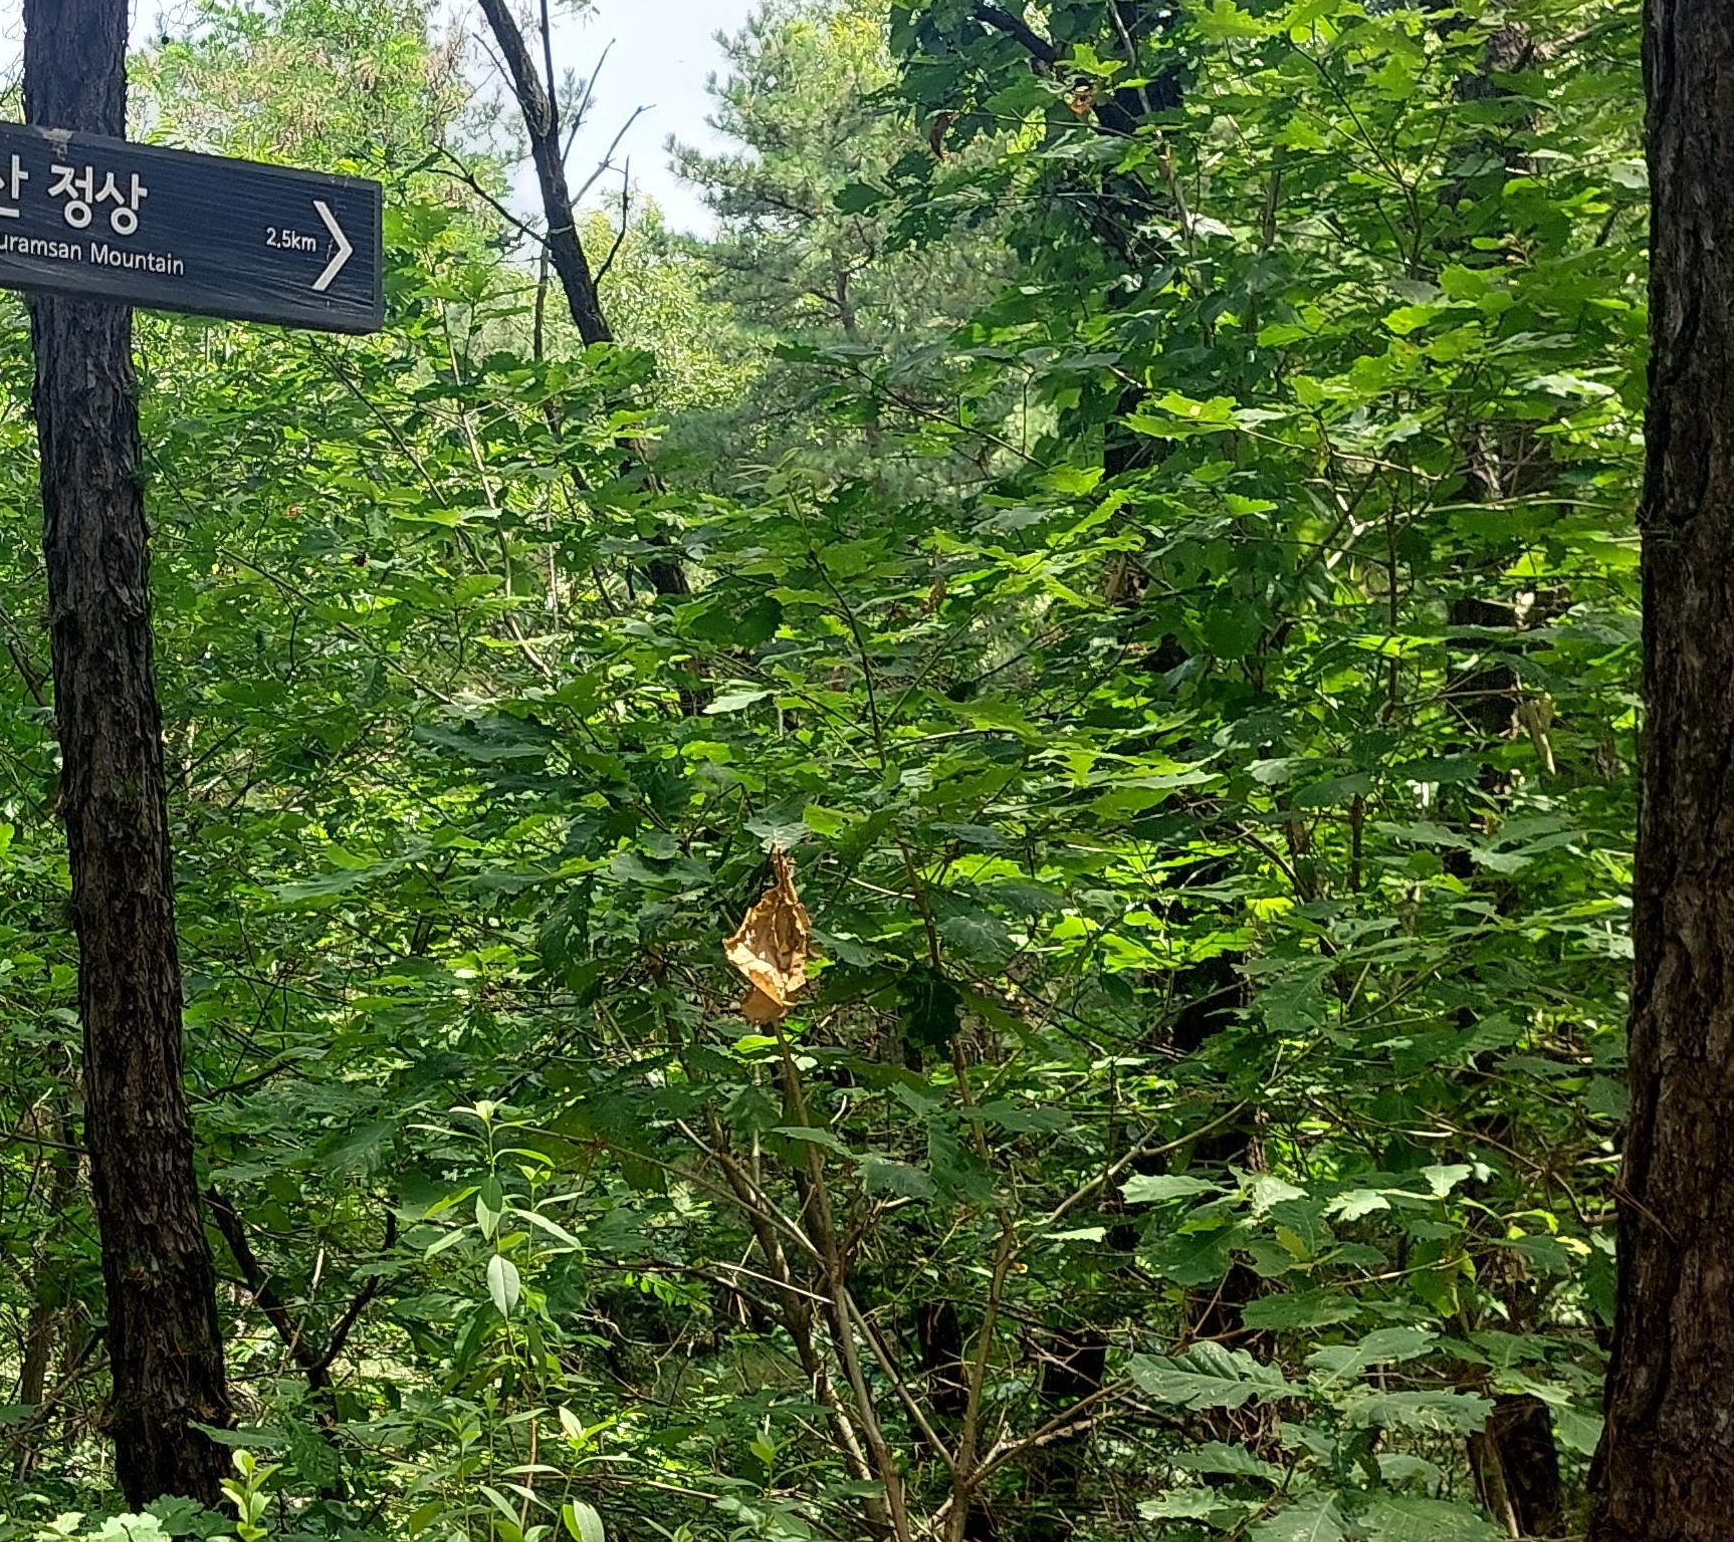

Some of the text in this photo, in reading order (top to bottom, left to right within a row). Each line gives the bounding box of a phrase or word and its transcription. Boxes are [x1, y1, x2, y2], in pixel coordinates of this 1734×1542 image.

[48, 164, 148, 236] 정상
[266, 227, 317, 252] 2.5km
[91, 243, 185, 276] Mountain
